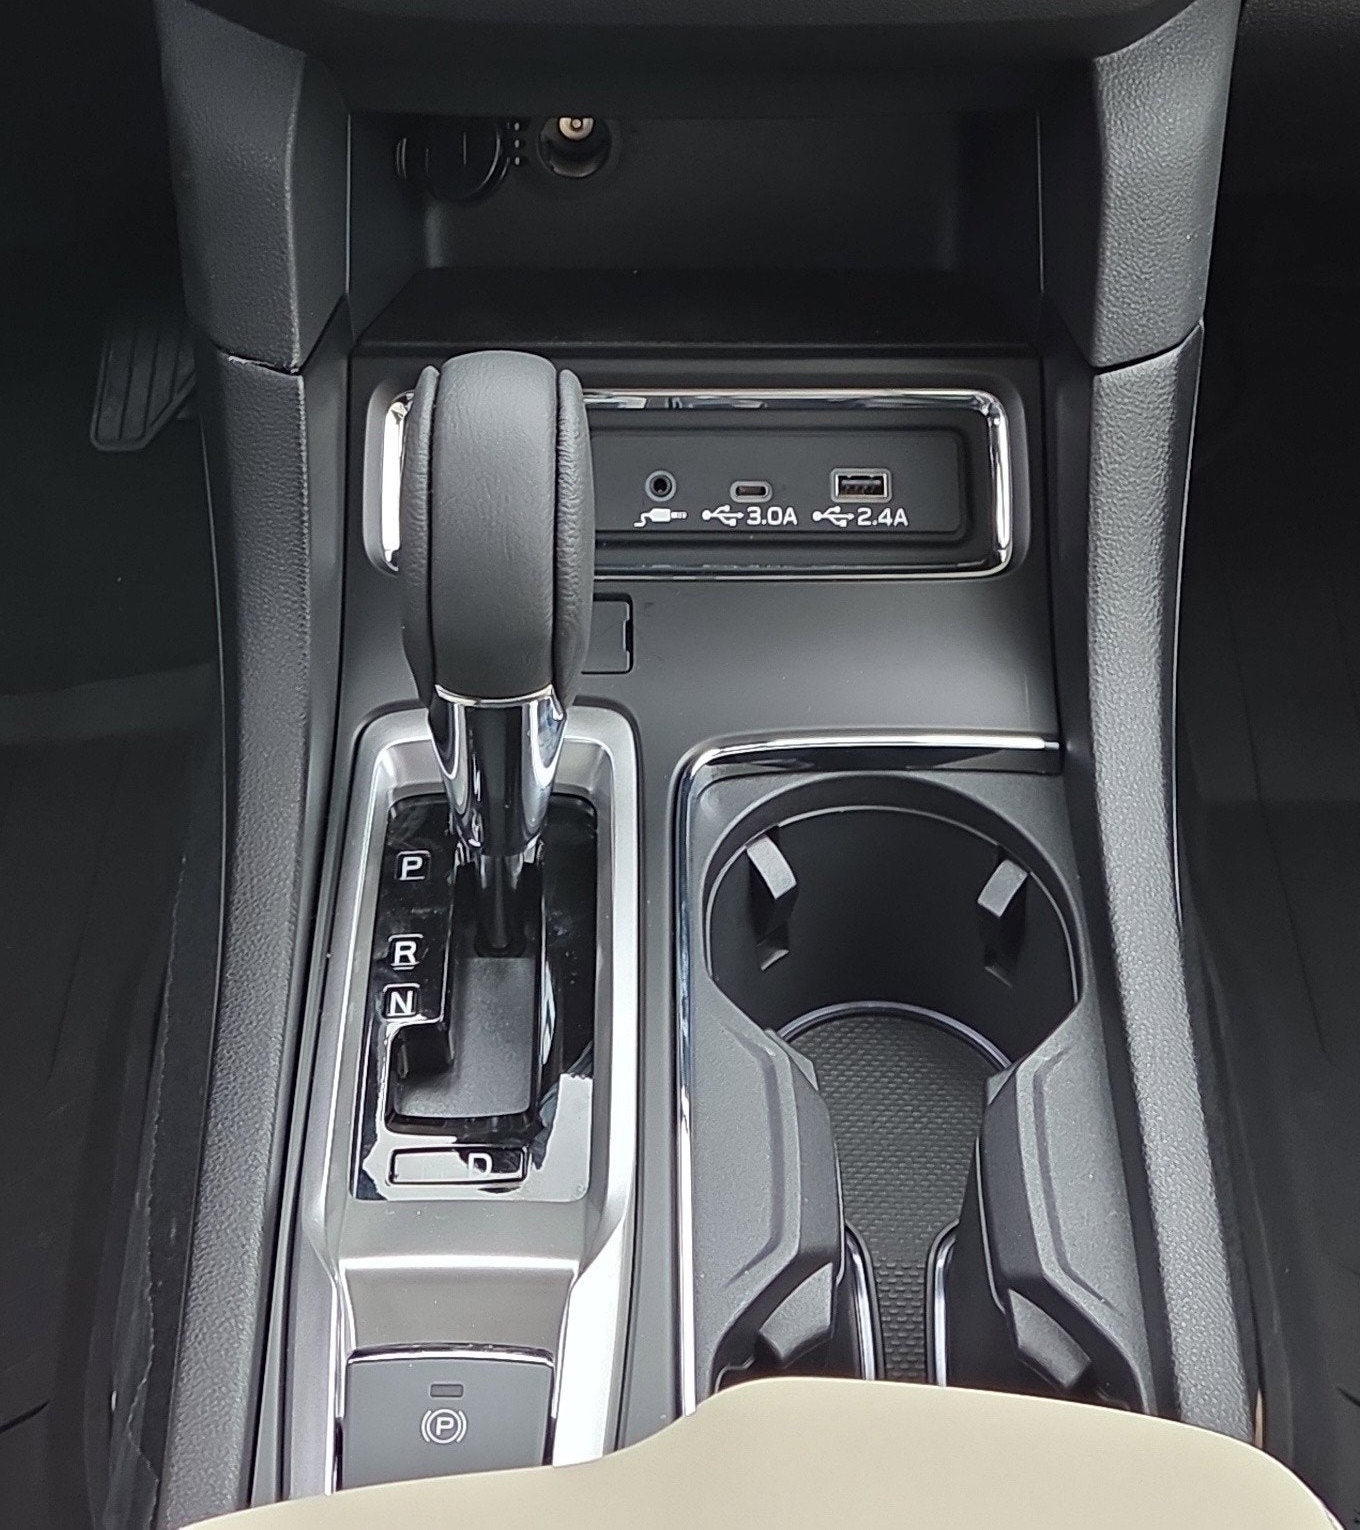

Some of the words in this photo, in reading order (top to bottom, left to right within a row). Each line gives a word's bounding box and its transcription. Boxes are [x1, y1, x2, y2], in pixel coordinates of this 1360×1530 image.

[746, 506, 798, 526] 3.0A
[857, 507, 909, 527] 2.4A
[401, 854, 424, 878] P
[394, 939, 417, 965] R
[389, 991, 414, 1014] N
[467, 1153, 492, 1175] D
